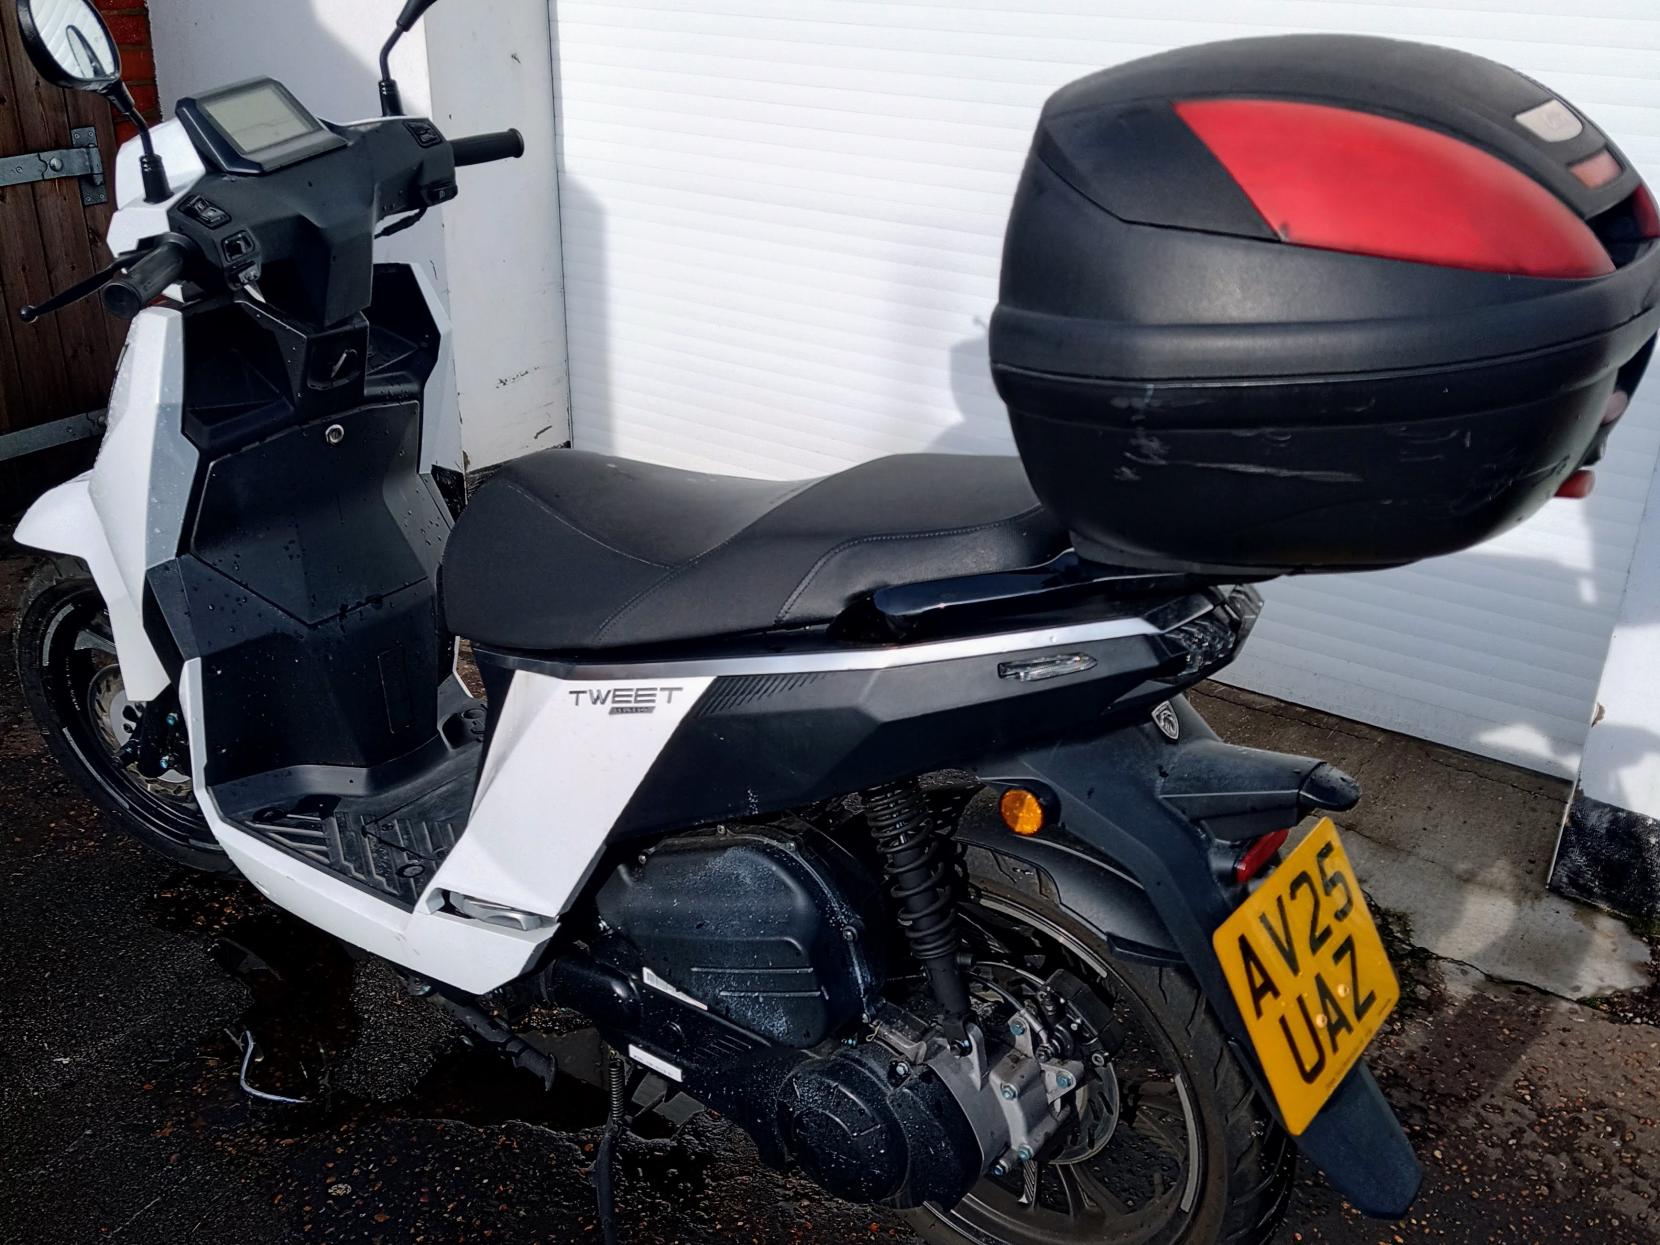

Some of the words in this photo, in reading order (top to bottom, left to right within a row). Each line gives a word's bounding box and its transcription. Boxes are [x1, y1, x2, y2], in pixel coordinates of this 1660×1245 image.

[569, 687, 683, 706] TWEET
[1238, 840, 1354, 1020] AV25
[1279, 934, 1377, 1084] UAZ
